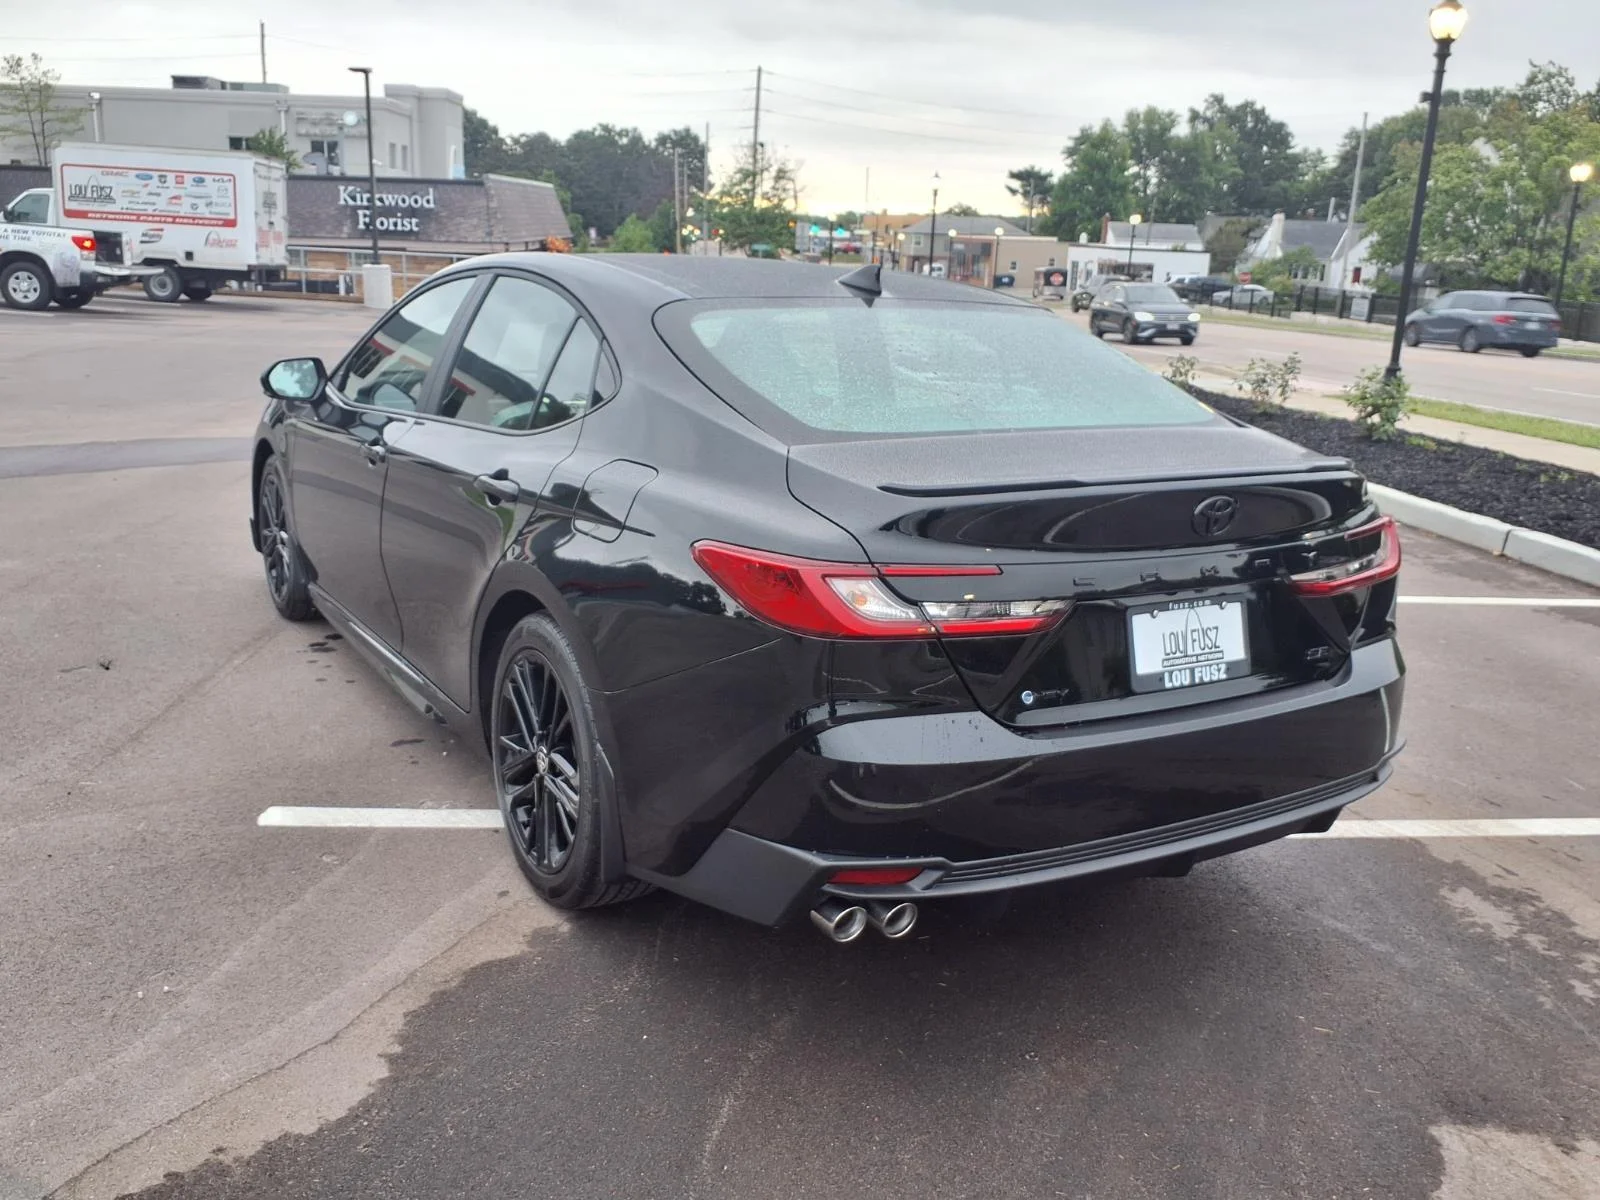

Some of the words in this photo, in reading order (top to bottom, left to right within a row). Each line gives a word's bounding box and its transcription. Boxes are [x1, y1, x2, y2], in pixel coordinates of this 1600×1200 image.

[69, 184, 87, 198] LOU
[91, 184, 113, 198] FUSZ
[356, 209, 419, 232] Forist
[1168, 599, 1211, 610] fusz.com
[1162, 630, 1184, 656] LOU
[1190, 625, 1220, 652] FUSZ
[1163, 655, 1197, 667] AUTOMOTIVE
[1197, 652, 1223, 662] NETWORK
[1164, 668, 1190, 689] LOU
[1194, 663, 1227, 684] FUSZ
